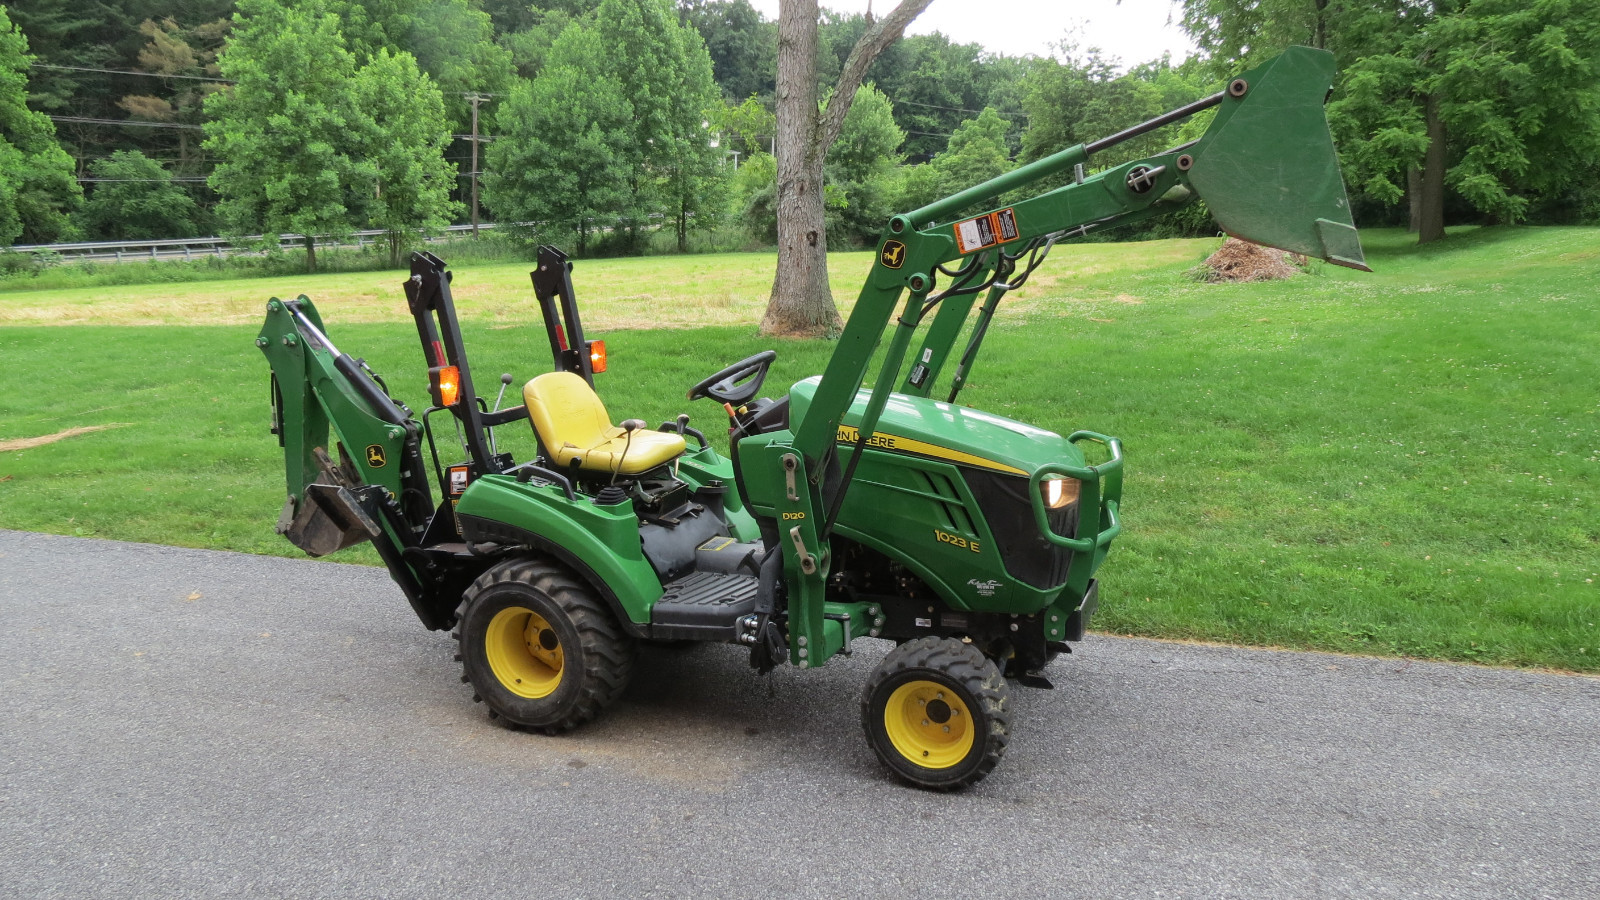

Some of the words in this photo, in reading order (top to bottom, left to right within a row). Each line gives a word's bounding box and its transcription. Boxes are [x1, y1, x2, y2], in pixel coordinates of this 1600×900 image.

[853, 431, 896, 448] DERE
[934, 529, 967, 548] 1023
[969, 541, 981, 553] E
